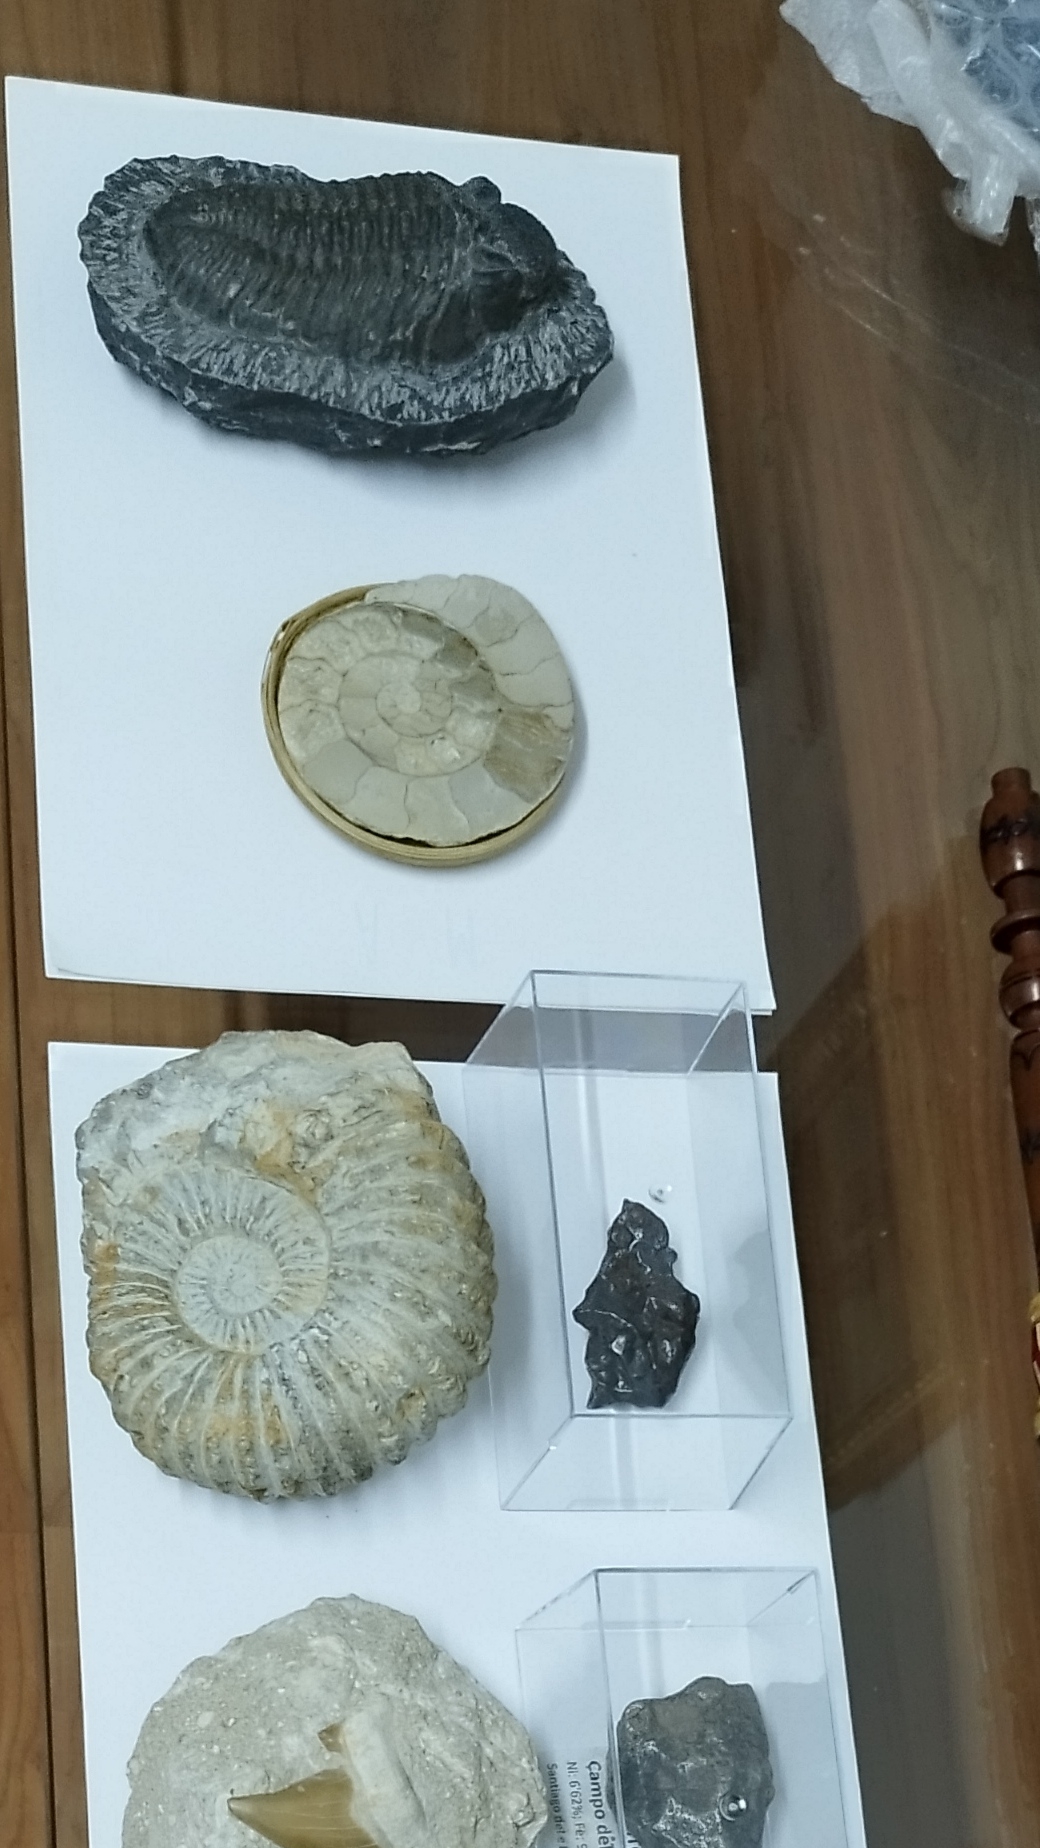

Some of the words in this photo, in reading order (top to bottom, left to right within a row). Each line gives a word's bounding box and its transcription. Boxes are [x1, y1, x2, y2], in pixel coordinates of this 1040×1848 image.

[547, 1763, 561, 1813] Santiago
[566, 1761, 579, 1777] Ni:
[574, 1823, 586, 1841] Fe:
[587, 1760, 605, 1820] Campo
